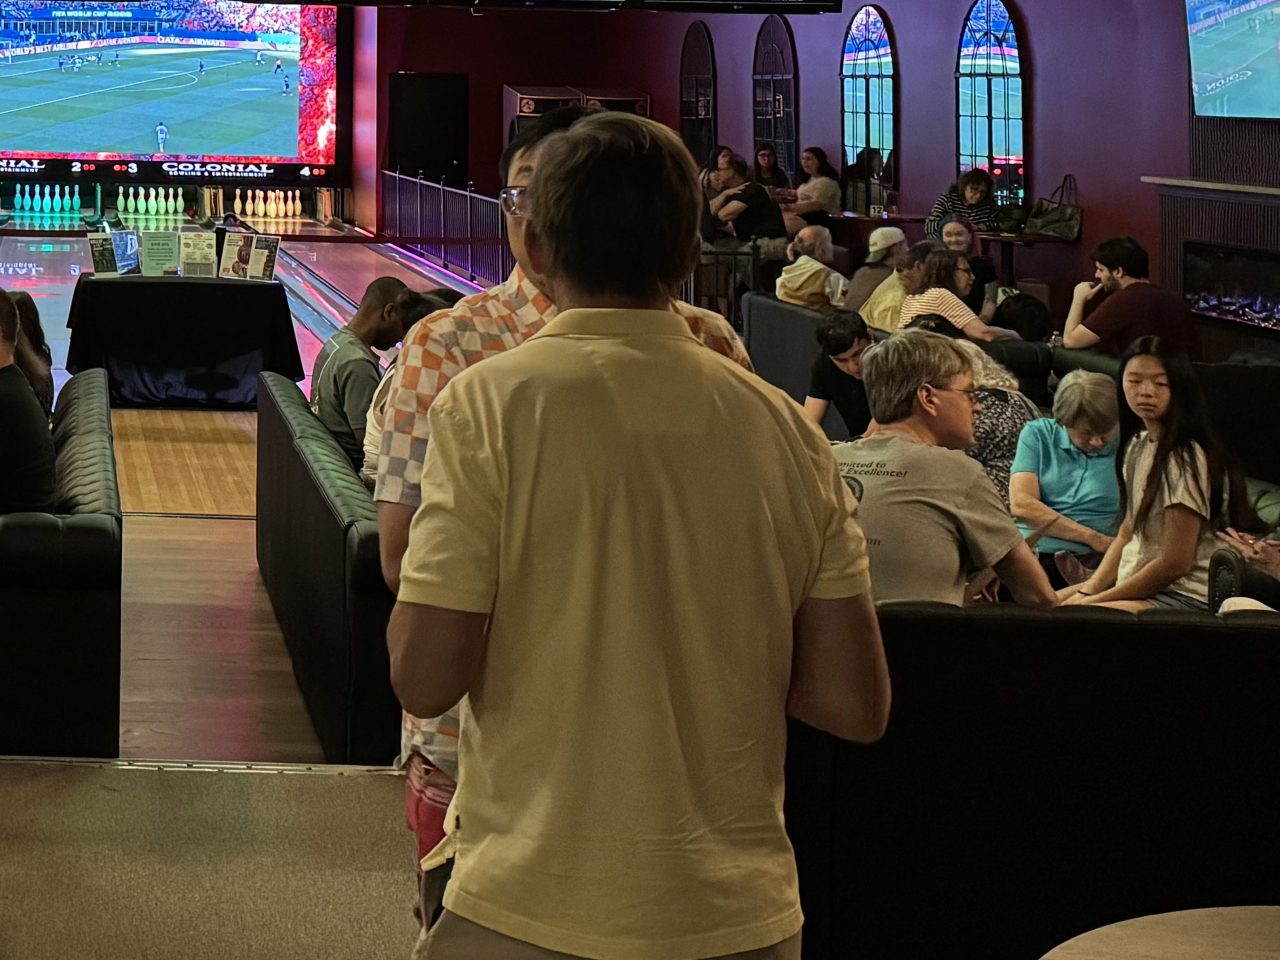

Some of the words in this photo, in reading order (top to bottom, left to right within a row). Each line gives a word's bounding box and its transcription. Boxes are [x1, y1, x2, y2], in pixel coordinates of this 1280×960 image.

[189, 38, 226, 47] AIRWAYS
[4, 46, 35, 57] WORLD'S
[35, 44, 52, 54] BEST
[71, 161, 82, 172] 2
[127, 162, 138, 173] 3
[161, 162, 275, 173] COLONIAL
[299, 166, 311, 177] 4
[872, 206, 883, 214] 12
[846, 467, 908, 479] Excellence!
